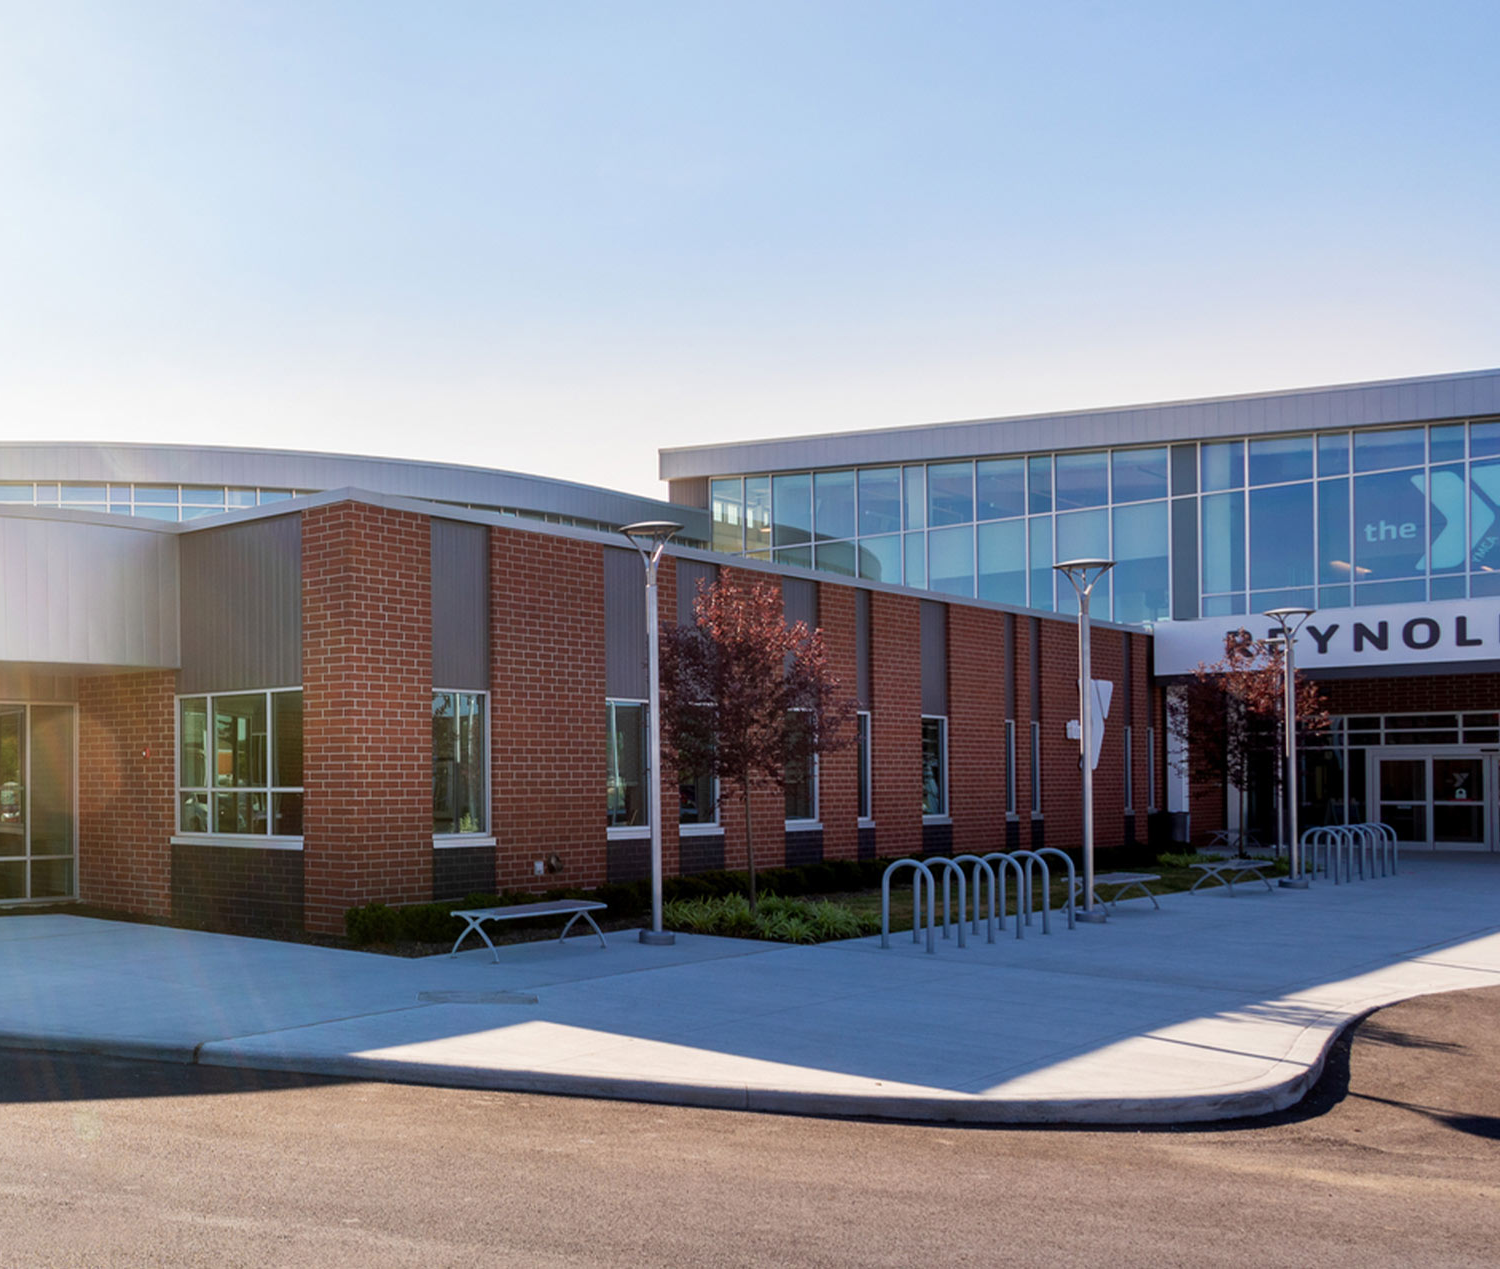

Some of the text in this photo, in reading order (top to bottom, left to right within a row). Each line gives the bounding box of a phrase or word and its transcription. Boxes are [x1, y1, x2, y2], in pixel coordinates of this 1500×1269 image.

[1363, 520, 1417, 542] the
[1472, 535, 1499, 562] YMCA
[1227, 615, 1500, 658] REYNOL
